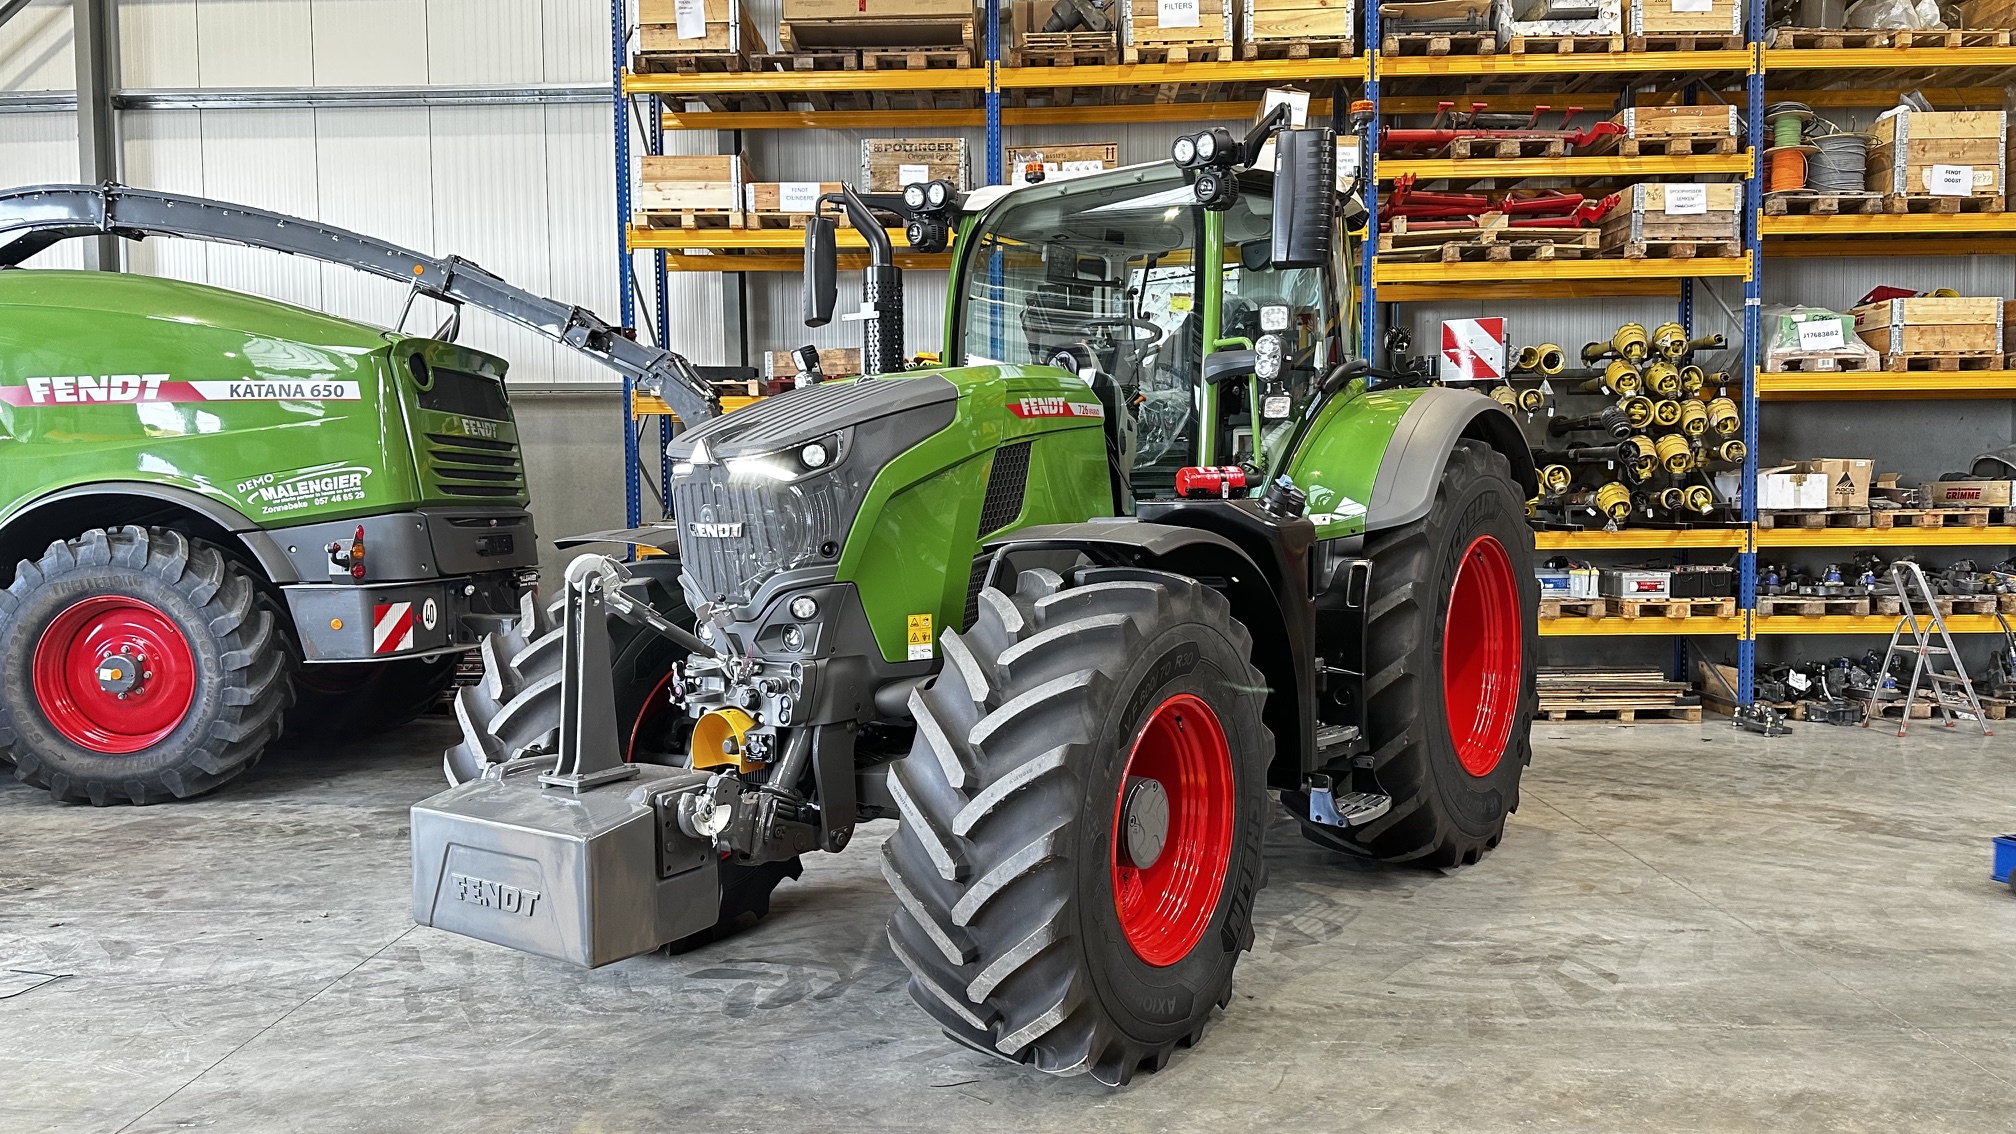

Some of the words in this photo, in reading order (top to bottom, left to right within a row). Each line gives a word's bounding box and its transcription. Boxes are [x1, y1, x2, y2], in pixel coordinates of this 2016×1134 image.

[1164, 2, 1193, 10] FILTERS
[907, 152, 935, 161] Original
[26, 374, 171, 403] FENDT
[229, 384, 305, 399] KATANA
[310, 384, 345, 398] 650
[1019, 397, 1066, 416] FENDT
[1077, 404, 1089, 415] 726
[461, 418, 498, 438] FENDT
[236, 473, 274, 494] DEMO
[258, 473, 362, 501] MALENGIER
[261, 501, 309, 515] Zonnebeke
[314, 496, 329, 506] 057
[331, 494, 342, 503] 46
[343, 492, 354, 501] 65
[355, 490, 366, 499] 29
[1945, 491, 1981, 500] GRIMME
[425, 604, 435, 624] 40
[1174, 651, 1195, 670] R30
[451, 872, 541, 917] FENDT
